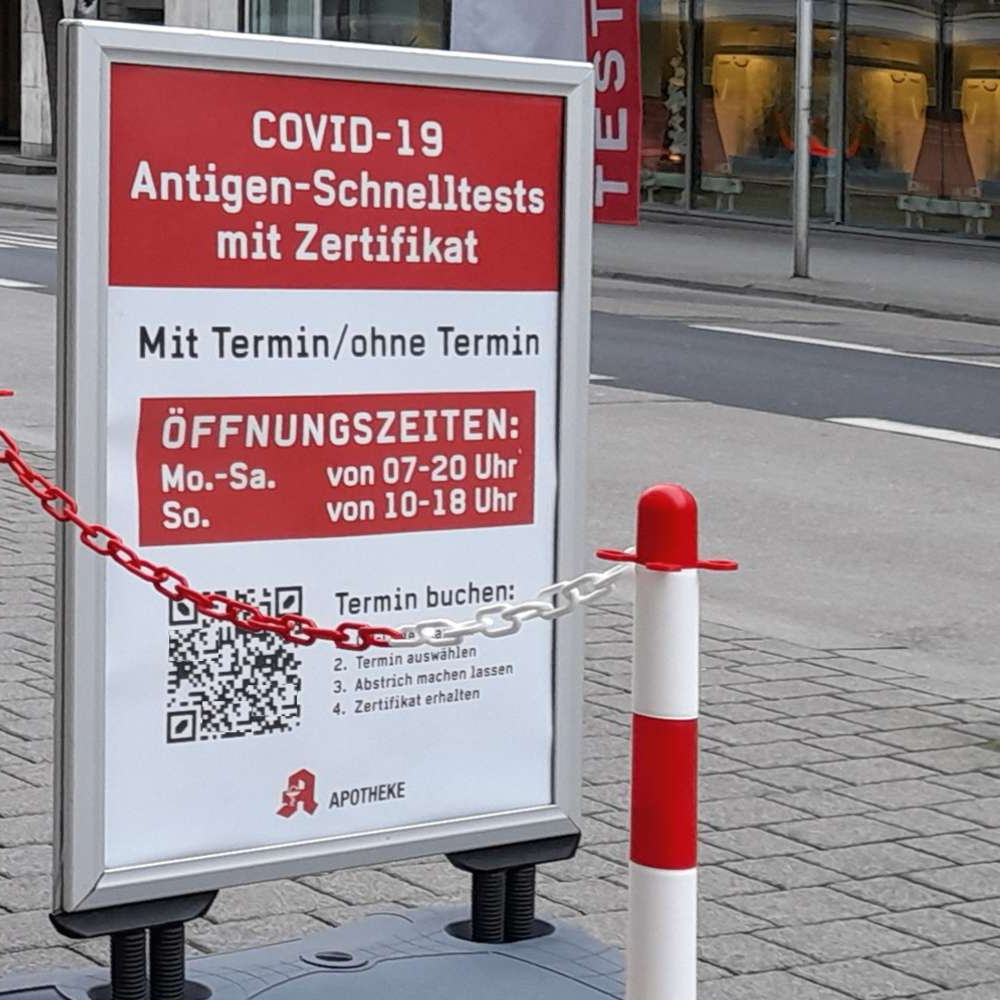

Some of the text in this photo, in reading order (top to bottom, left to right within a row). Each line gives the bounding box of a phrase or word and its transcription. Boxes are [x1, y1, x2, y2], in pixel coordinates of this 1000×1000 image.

[591, 0, 629, 207] TEST
[252, 110, 444, 157] COVID-19
[130, 161, 546, 214] Antigen-Schnelltests
[216, 221, 479, 265] mit Zertifikat
[139, 323, 540, 362] Mit Termin/ohne Termin
[161, 408, 520, 450] ÖFFNUNGSZEITEN:
[161, 453, 518, 493] Mo.-Sa. von 07-20 Uhr
[163, 487, 518, 529] So. von 10-18 Uhr
[335, 582, 515, 615] Termin buchen:
[333, 646, 477, 672] 2. Termin auswählen
[333, 664, 514, 693] 3. Abstrich machen lassen
[332, 688, 480, 716] 4. Zertifikat erhalten
[329, 781, 406, 809] APOTHEKE
